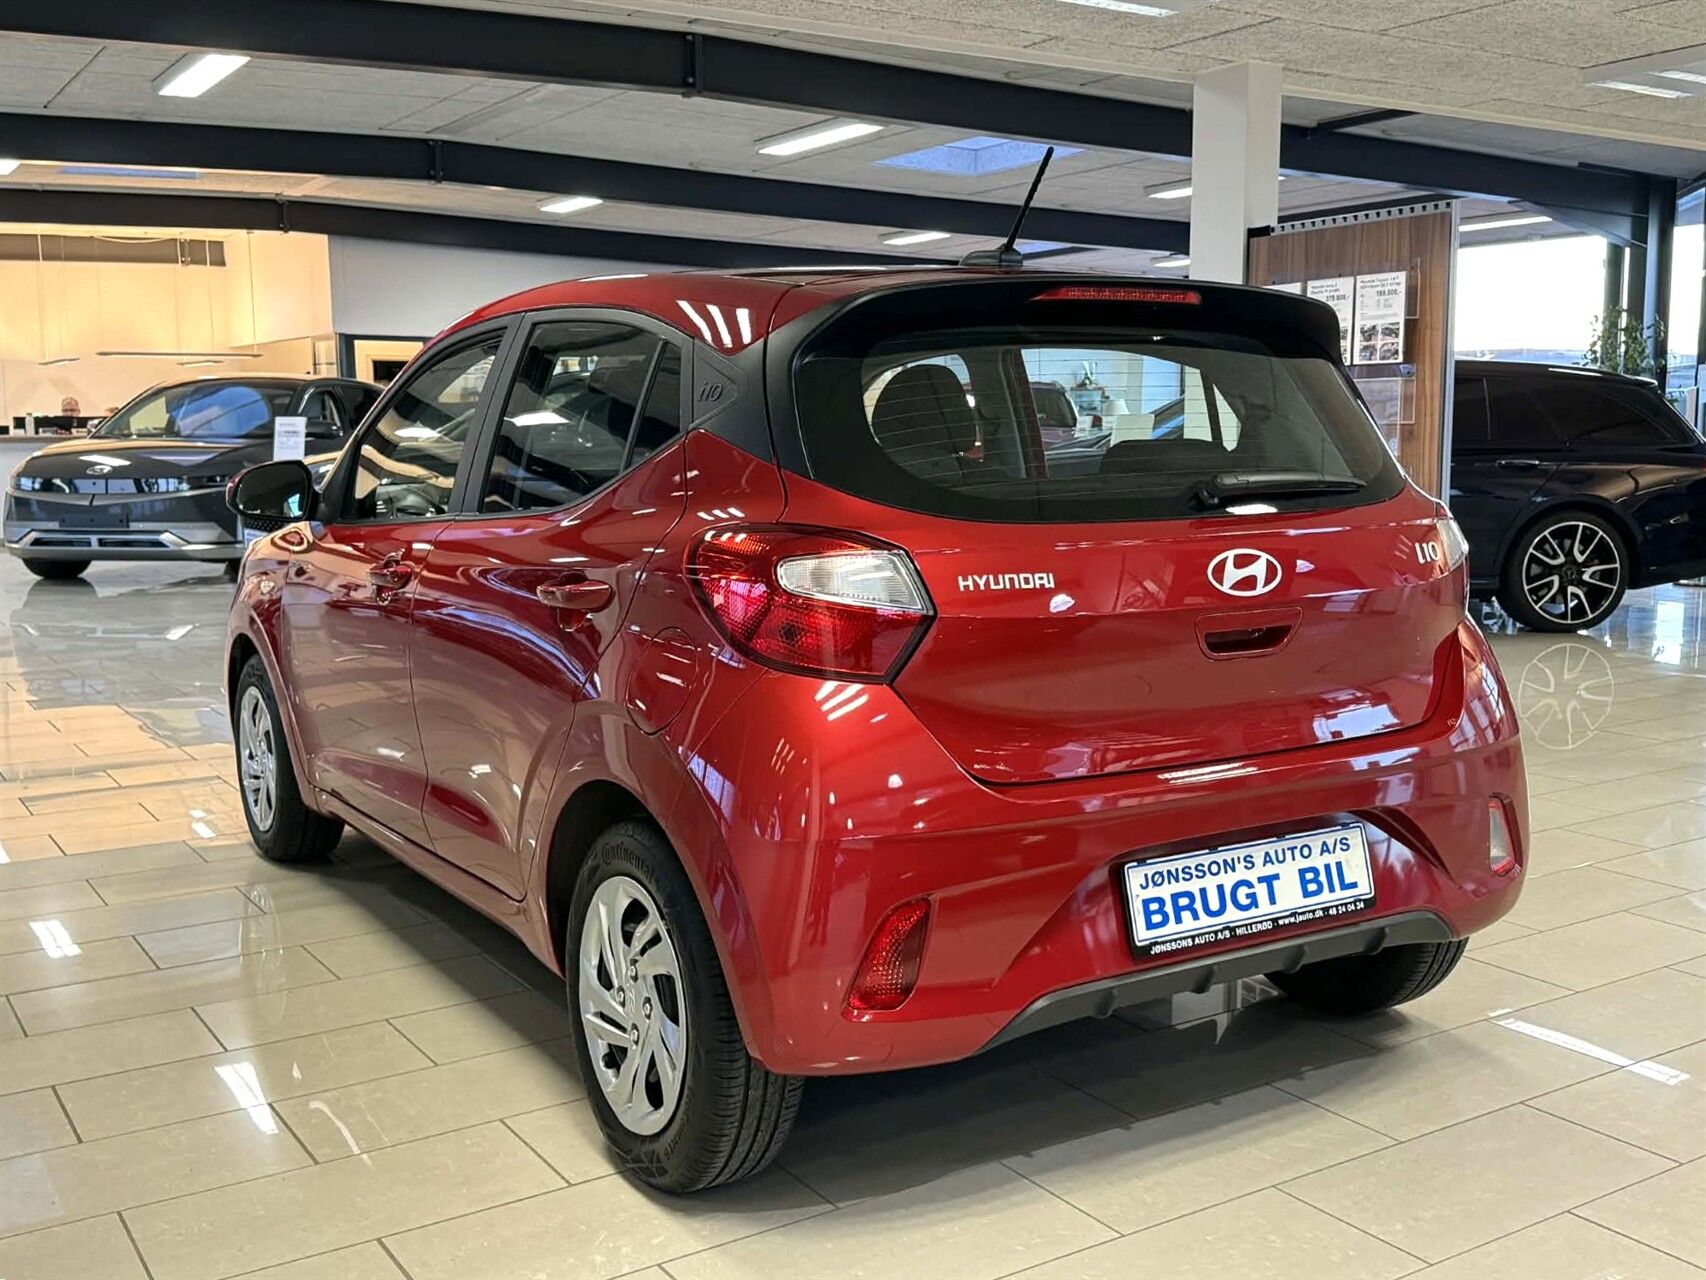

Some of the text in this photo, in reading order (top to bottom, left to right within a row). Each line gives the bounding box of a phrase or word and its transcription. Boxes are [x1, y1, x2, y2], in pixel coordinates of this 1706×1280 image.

[957, 573, 1055, 591] HYUNDAI
[1139, 837, 1351, 890] JØNSSON'S AUTO A/S
[1141, 861, 1359, 931] BRUGT BIL
[1150, 938, 1193, 955] JØNSSONS
[1194, 931, 1216, 945] AUTO
[1217, 929, 1231, 939] A/S
[1235, 921, 1273, 936] HILLERØD
[1278, 909, 1324, 926] www.jauto.dk
[1338, 904, 1347, 913] 24
[1347, 903, 1356, 912] 04
[1356, 901, 1365, 910] 34
